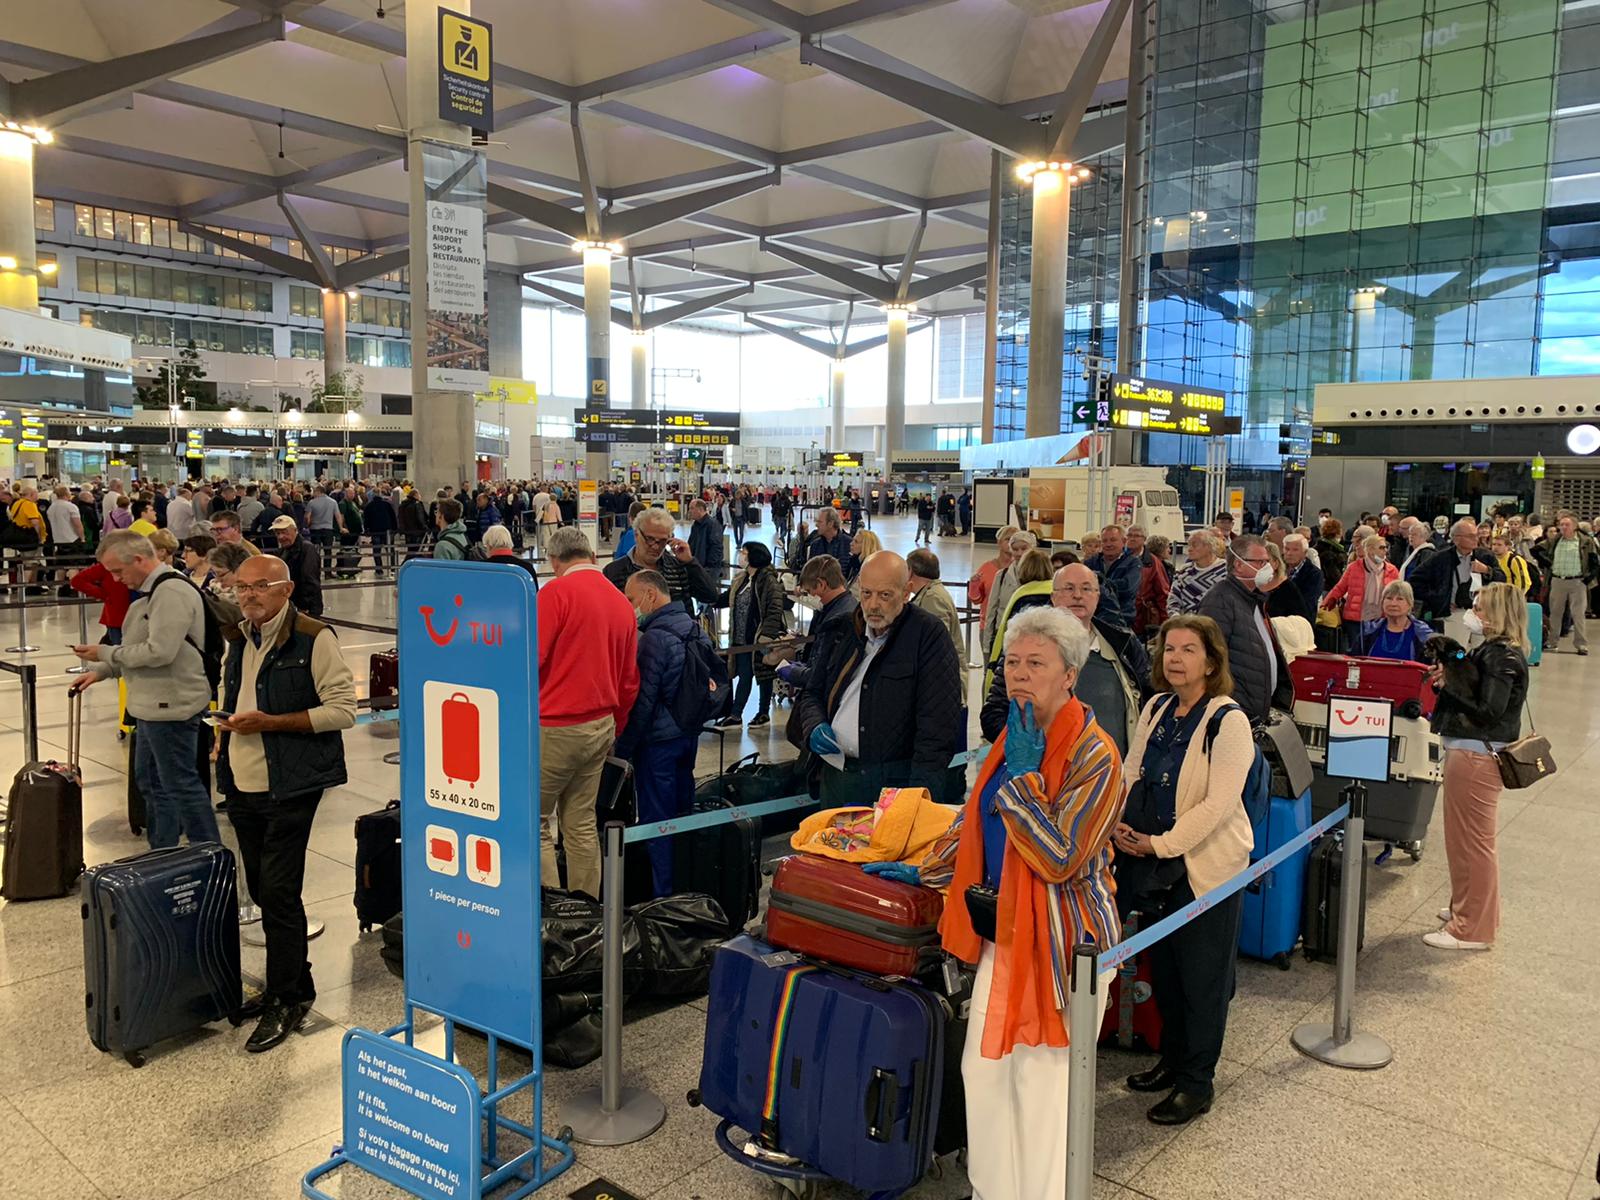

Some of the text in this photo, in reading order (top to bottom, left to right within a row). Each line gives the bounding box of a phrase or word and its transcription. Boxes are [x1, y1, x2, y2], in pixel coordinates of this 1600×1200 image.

[448, 83, 485, 99] Security control
[450, 92, 474, 104] Control
[452, 102, 482, 115] seguridad
[432, 225, 469, 236] ENJOY THE
[432, 234, 462, 244] AIRPORT
[432, 243, 456, 253] SHOPS
[432, 252, 480, 265] RESTAURANTS
[433, 262, 457, 271] Disfruta
[443, 272, 464, 280] tiendas
[439, 280, 475, 289] restaurantes
[444, 288, 476, 297] aeropuerto
[468, 621, 502, 648] TUI
[1365, 716, 1385, 726] TUI
[430, 789, 440, 800] 55
[449, 793, 459, 804] 40
[469, 797, 479, 808] 20
[481, 802, 495, 812] cm
[429, 888, 500, 916] 1 piece per person
[358, 1051, 407, 1079] Als het past,
[367, 1067, 380, 1080] het
[382, 1074, 413, 1094] welkom
[414, 1089, 430, 1103] aan
[431, 1095, 456, 1114] boord
[358, 1090, 388, 1112] If it fits,
[365, 1106, 372, 1118] is
[375, 1112, 410, 1135] welcome
[412, 1129, 423, 1141] on
[424, 1134, 449, 1154] board
[358, 1127, 460, 1186] Si votre bagage rentre ici,
[358, 1141, 454, 1196] il est le bienvenu à bord
